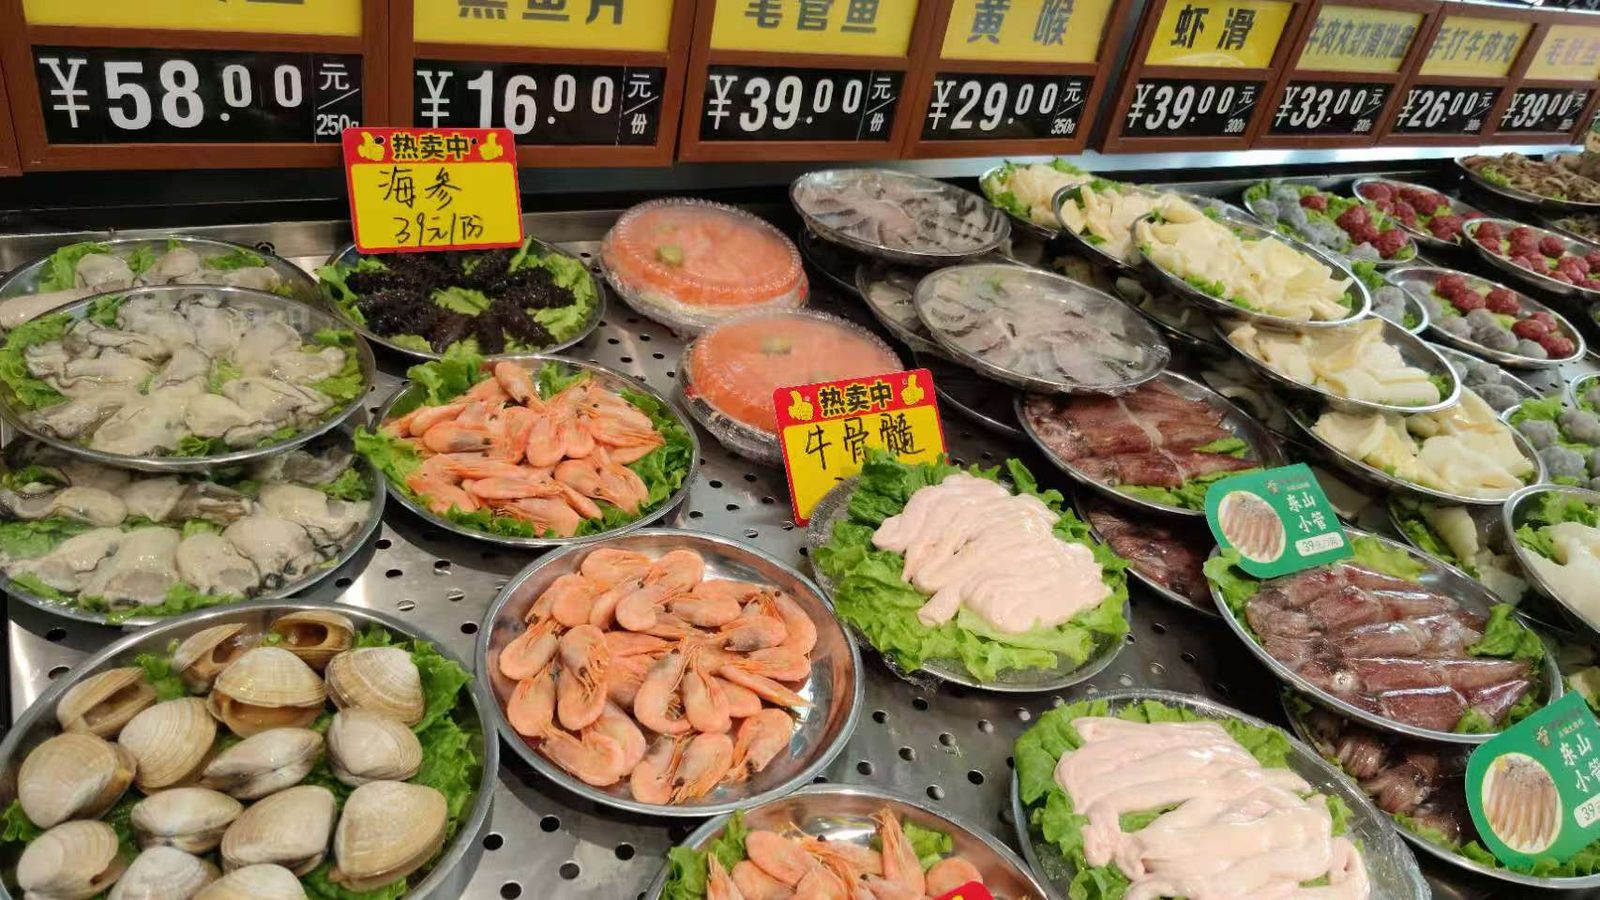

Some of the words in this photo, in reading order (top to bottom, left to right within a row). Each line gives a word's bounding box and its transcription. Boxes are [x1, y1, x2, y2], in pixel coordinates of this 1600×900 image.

[1170, 4, 1256, 50] 虾滑
[1051, 118, 1076, 134] 350g
[392, 133, 469, 159] 热卖中
[378, 165, 462, 211] 海参
[819, 381, 892, 416] 热卖中
[805, 412, 926, 470] 牛骨髓
[1299, 511, 1327, 533] 小管
